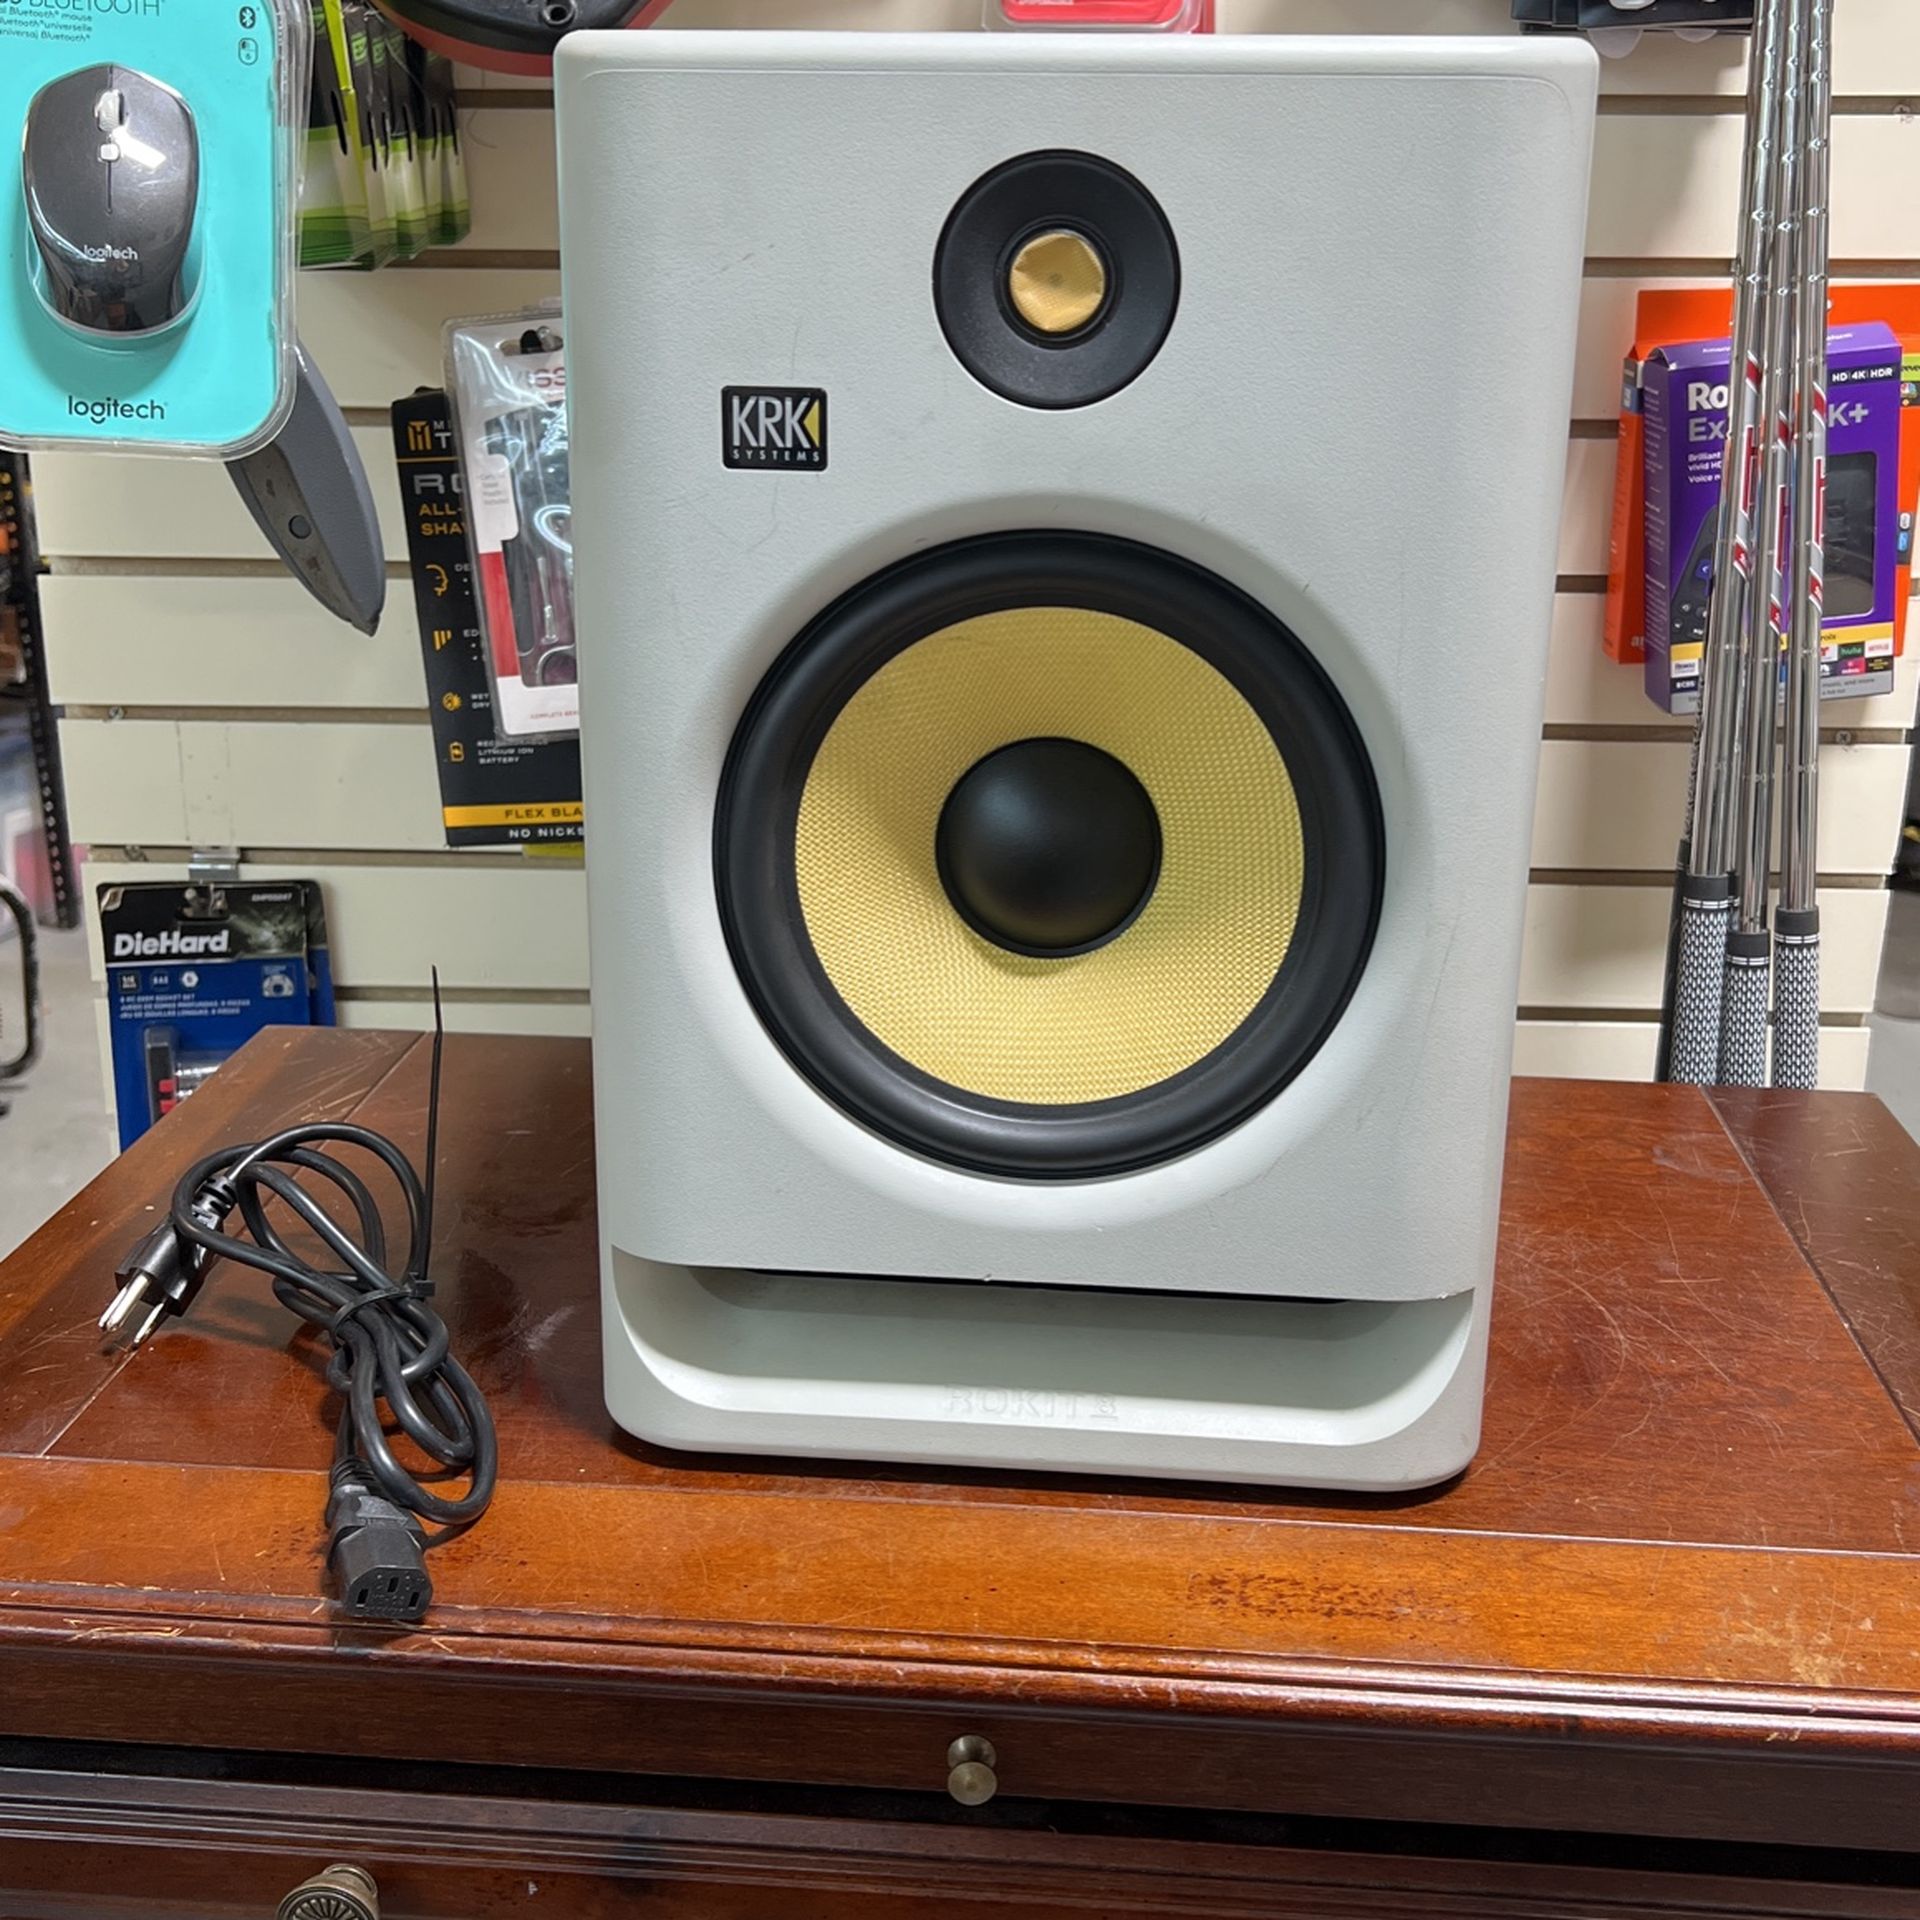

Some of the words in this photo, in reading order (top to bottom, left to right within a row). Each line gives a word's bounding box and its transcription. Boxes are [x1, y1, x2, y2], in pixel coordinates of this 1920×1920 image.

[1832, 373, 1848, 382] HD
[1870, 367, 1893, 378] HDR
[68, 395, 165, 424] logitech
[732, 395, 812, 450] KRK
[733, 449, 820, 462] SYSTEMS
[504, 808, 545, 819] FLEX
[509, 828, 531, 839] NO
[114, 929, 230, 957] DieHard
